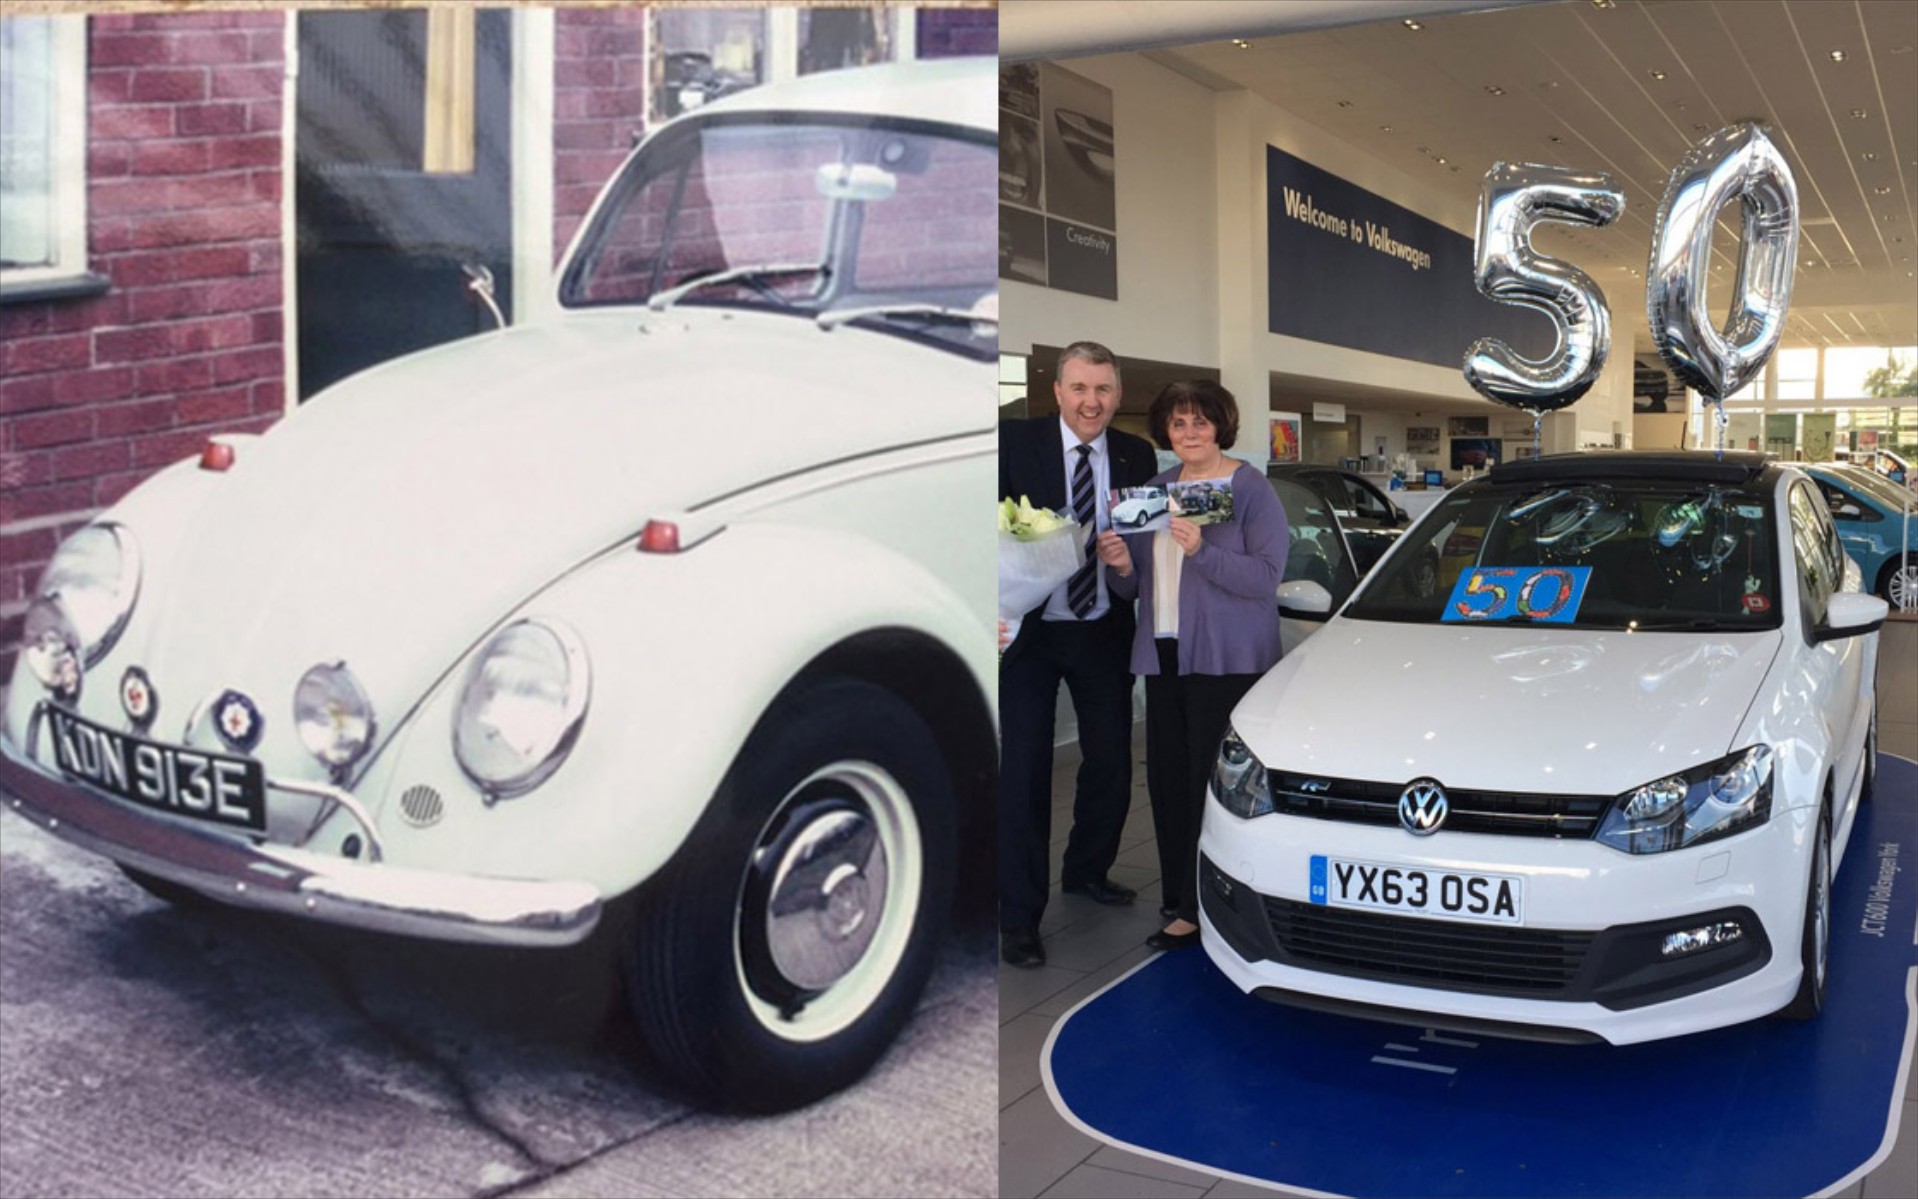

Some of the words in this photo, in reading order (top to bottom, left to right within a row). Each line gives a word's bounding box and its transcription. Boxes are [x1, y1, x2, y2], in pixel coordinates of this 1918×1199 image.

[1066, 226, 1110, 254] Creativity
[1283, 185, 1348, 238] Welcome
[1350, 218, 1363, 245] to
[1366, 221, 1431, 271] Volkswagen
[1464, 122, 1799, 412] 50
[1456, 568, 1575, 619] 50
[55, 711, 129, 792] KDN
[135, 744, 250, 821] 913E
[1877, 842, 1900, 857] York
[1334, 862, 1429, 908] YX63
[1440, 874, 1516, 918] OSA
[1867, 857, 1902, 903] Volkswagen
[1860, 903, 1889, 938] JCT600
